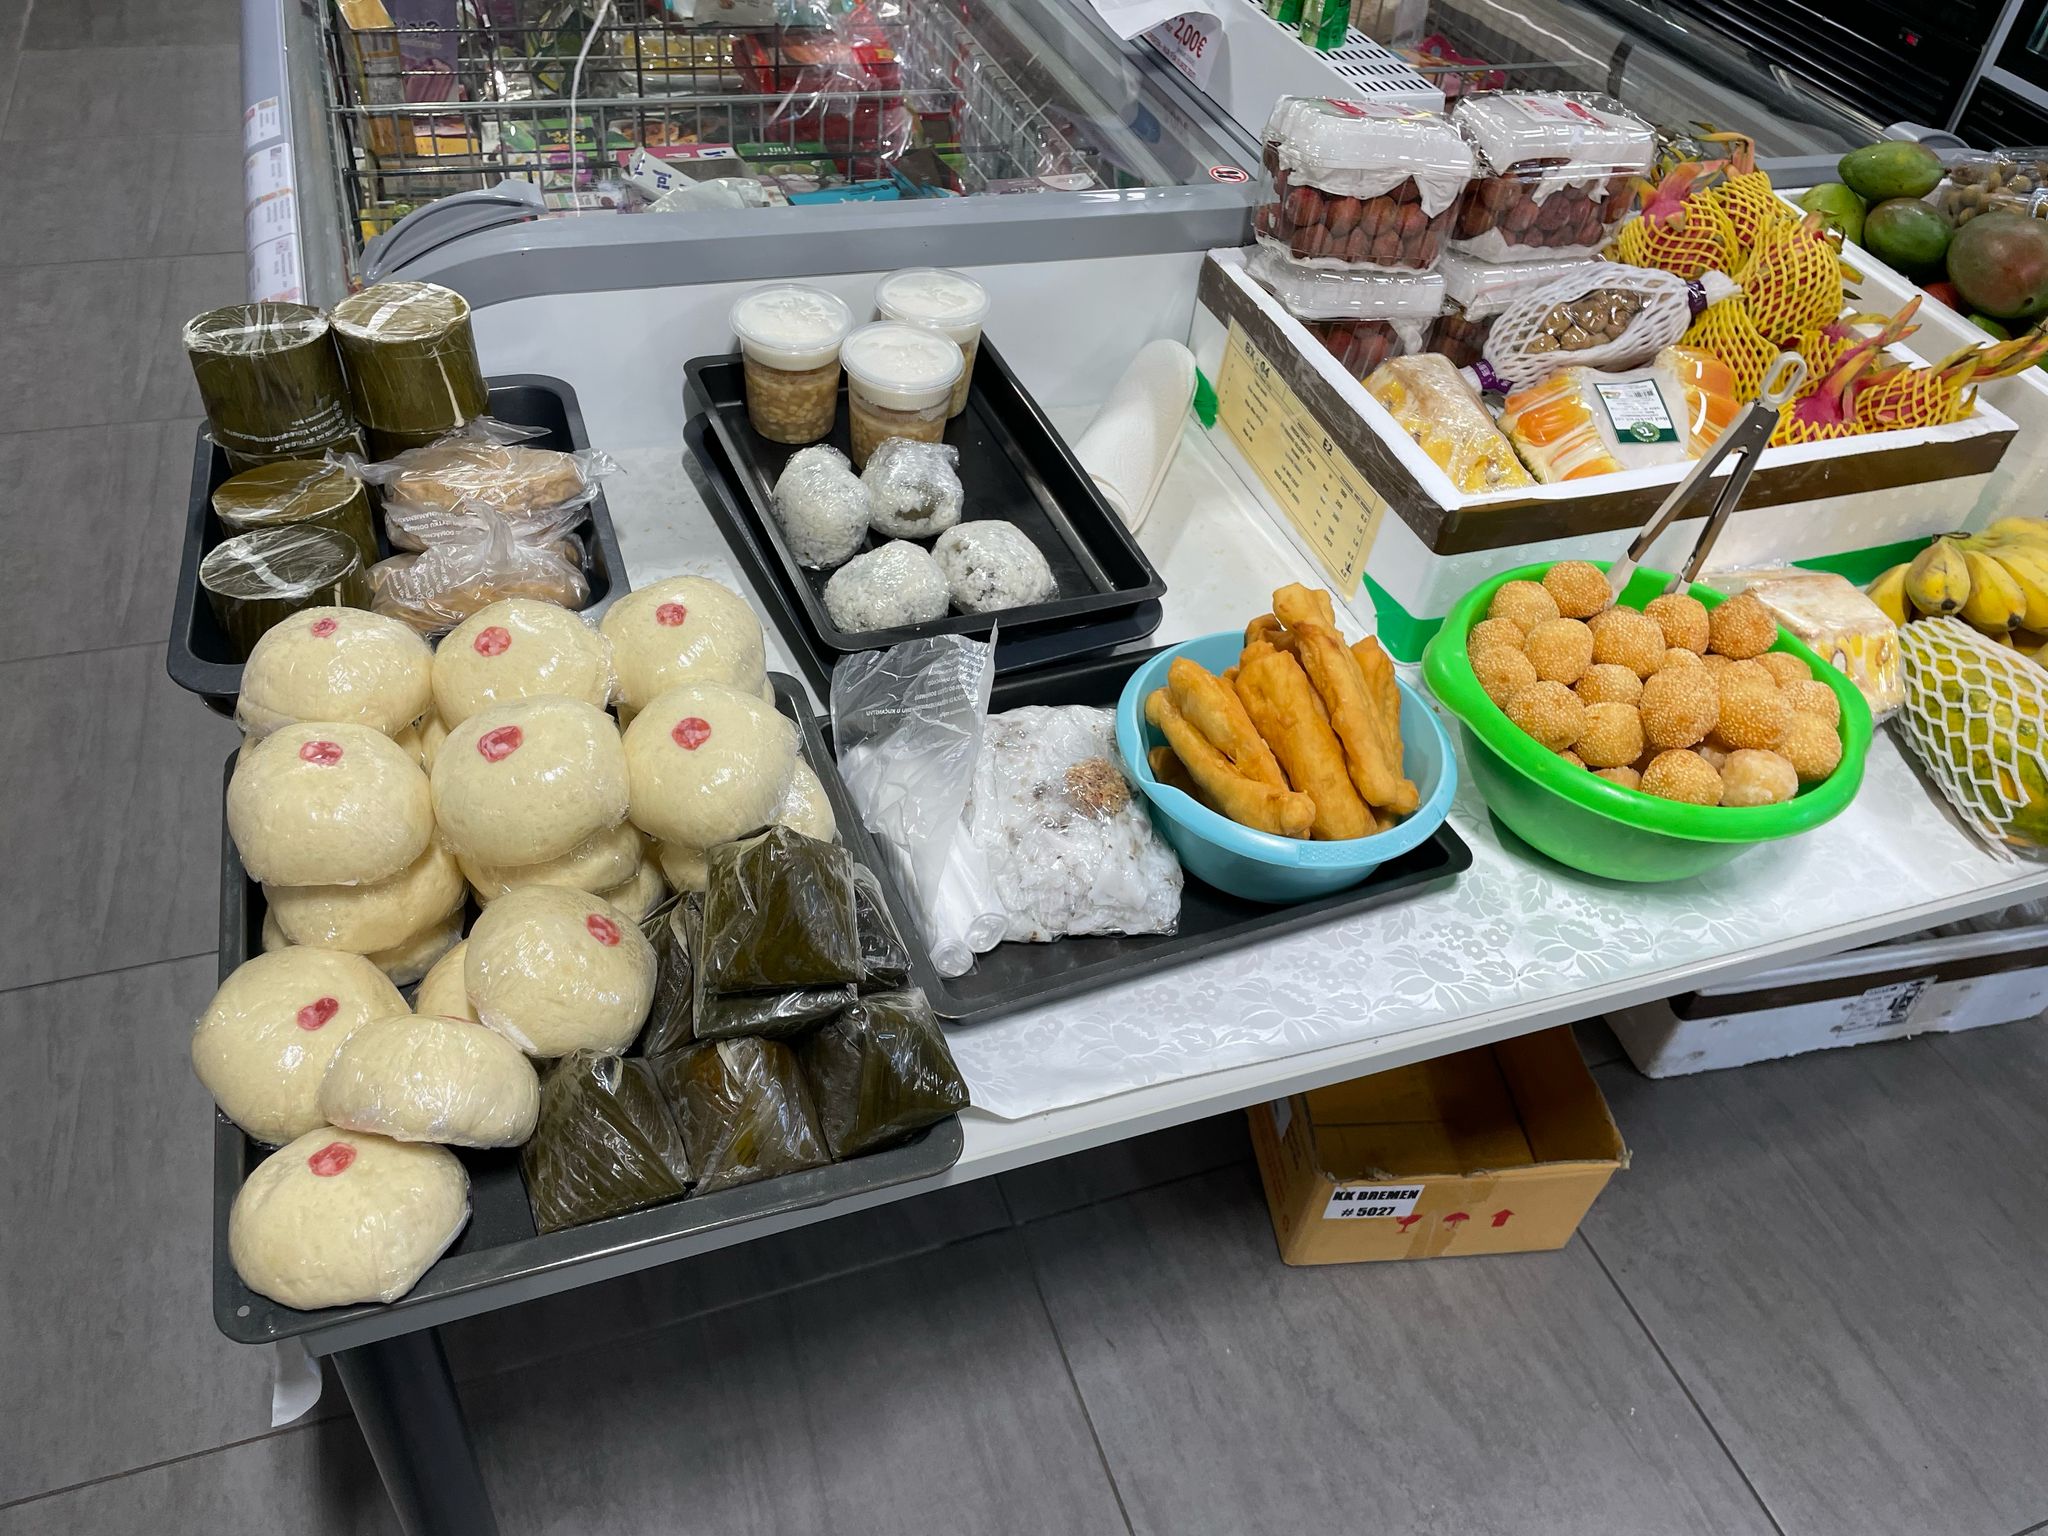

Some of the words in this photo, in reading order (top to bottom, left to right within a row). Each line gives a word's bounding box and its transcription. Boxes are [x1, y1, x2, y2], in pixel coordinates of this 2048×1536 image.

[1173, 17, 1208, 58] 2,00€
[652, 169, 672, 190] ja!
[1322, 438, 1334, 457] E2
[1333, 1191, 1356, 1200] KK
[1356, 1189, 1420, 1201] BREMEN
[1341, 1207, 1354, 1217] #
[1356, 1206, 1396, 1216] 5027
